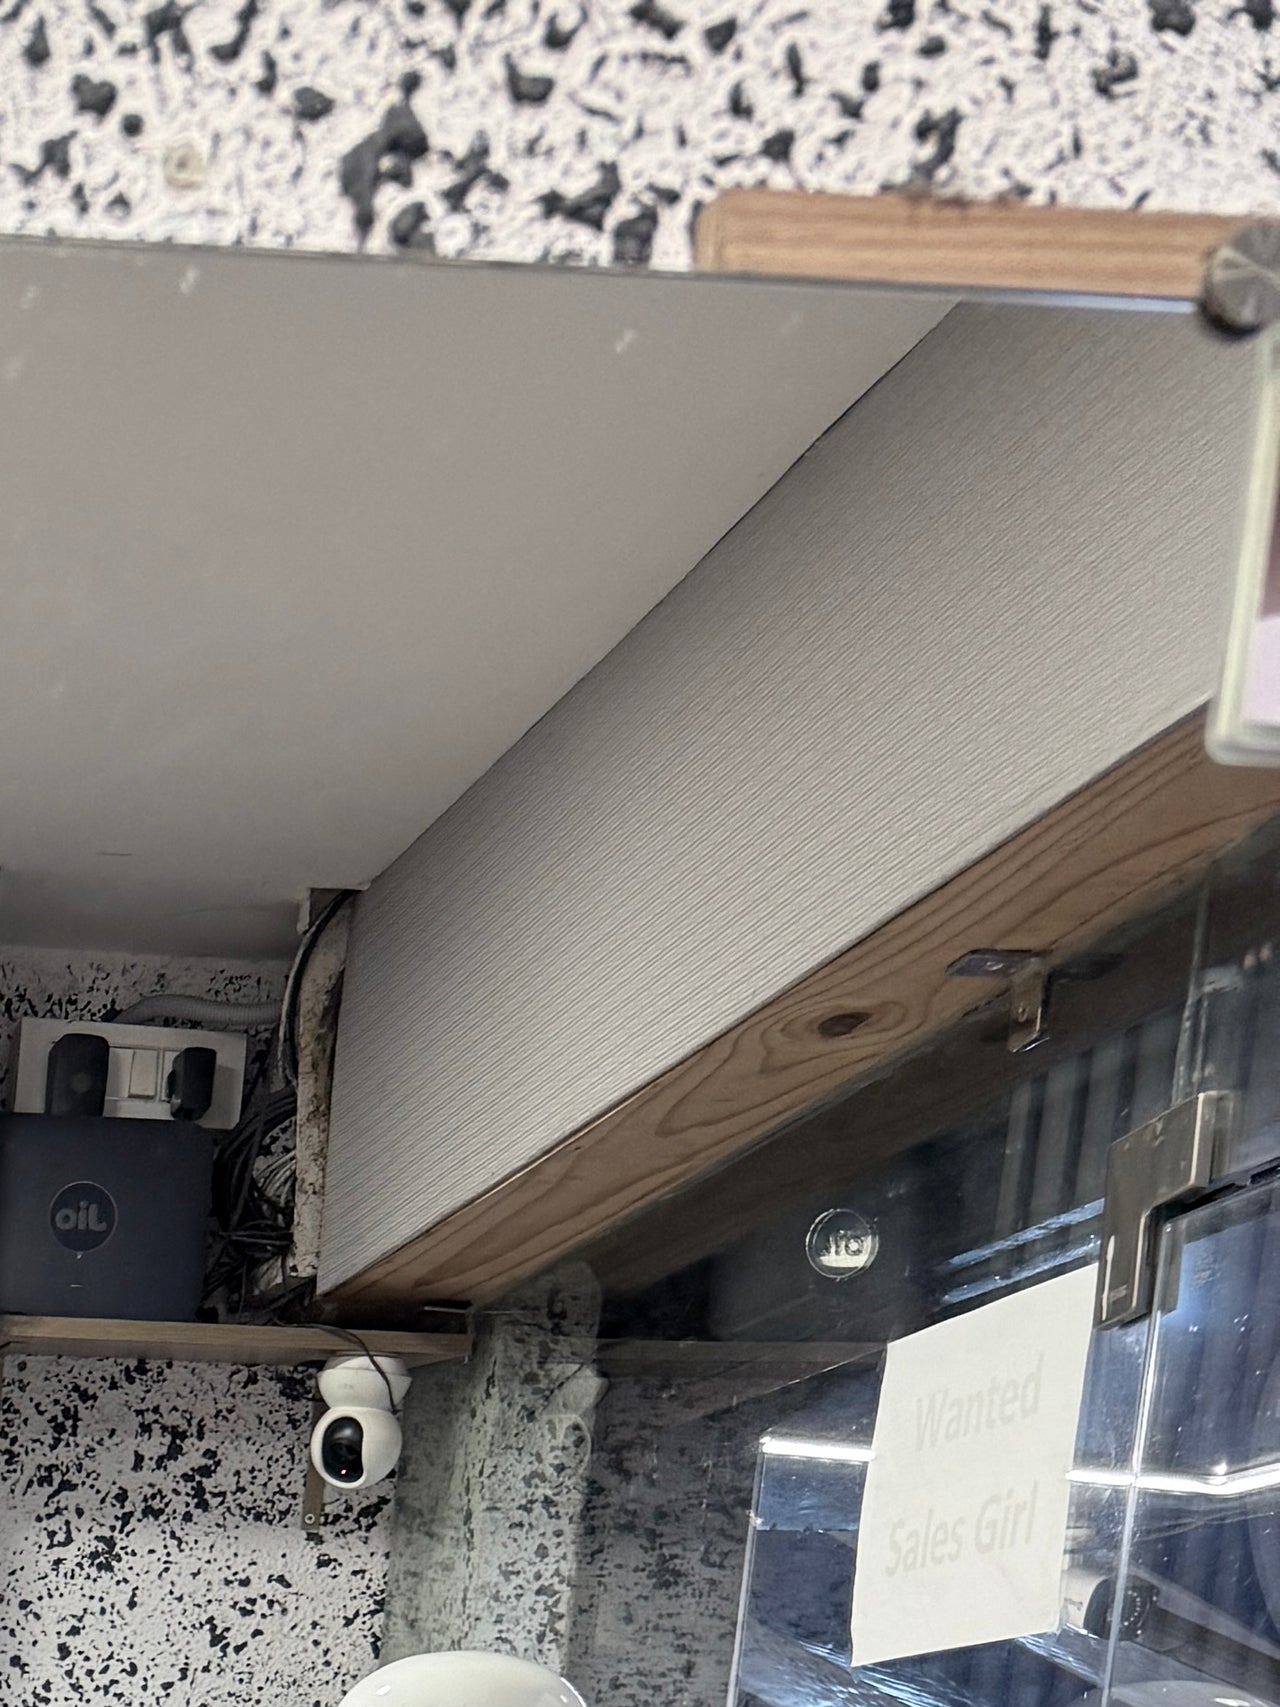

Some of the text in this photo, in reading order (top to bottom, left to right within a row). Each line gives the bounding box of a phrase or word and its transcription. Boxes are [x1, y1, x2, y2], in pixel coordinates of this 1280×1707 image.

[915, 1353, 1045, 1451] Wanted
[884, 1480, 1041, 1577] Sales Girl
